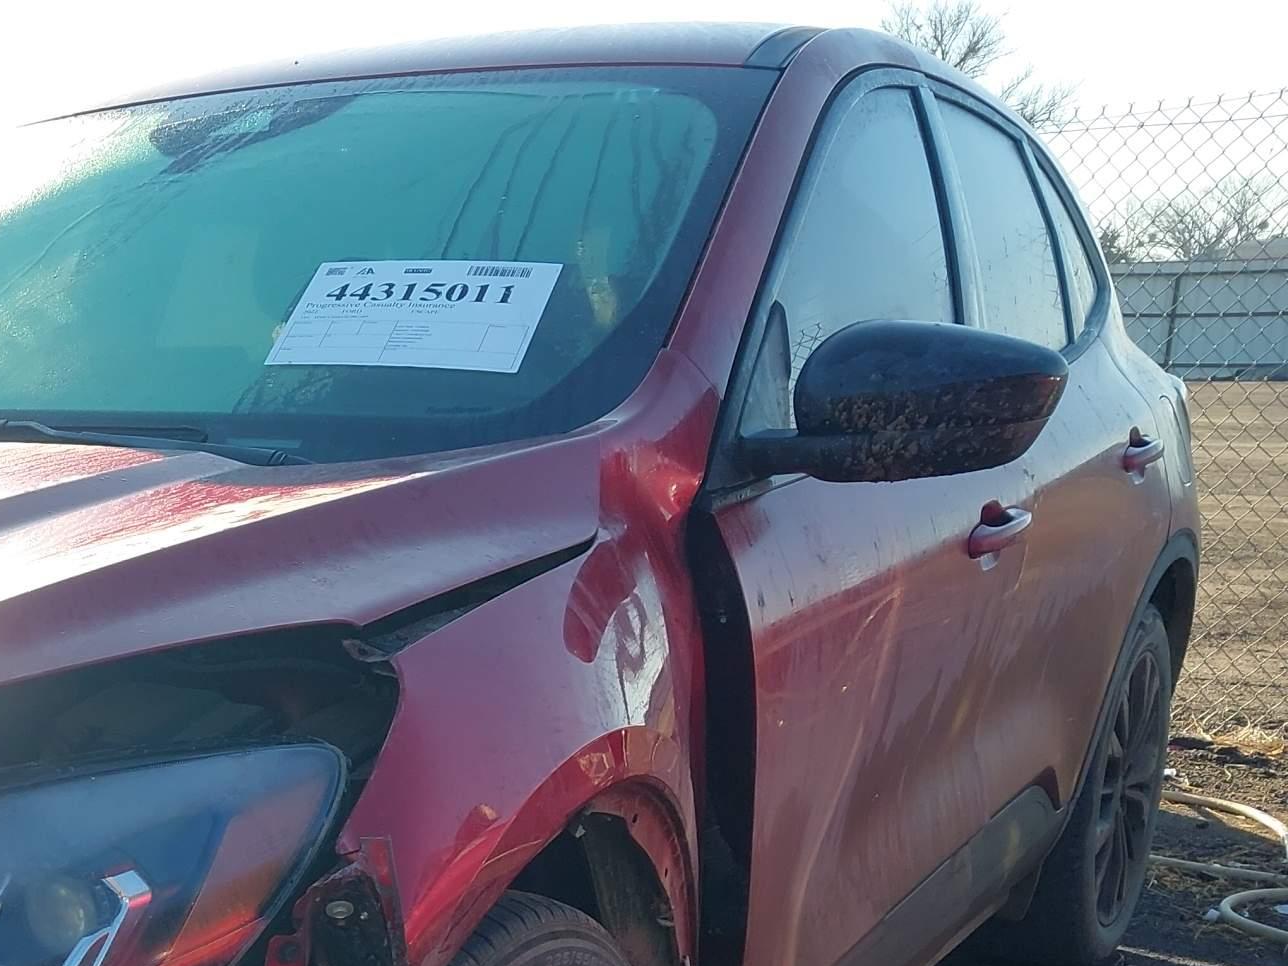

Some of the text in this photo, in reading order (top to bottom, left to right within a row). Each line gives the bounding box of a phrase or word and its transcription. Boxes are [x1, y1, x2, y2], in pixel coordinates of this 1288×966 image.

[326, 282, 515, 304] 44315011
[305, 301, 456, 310] Progressive Casualty Insurance
